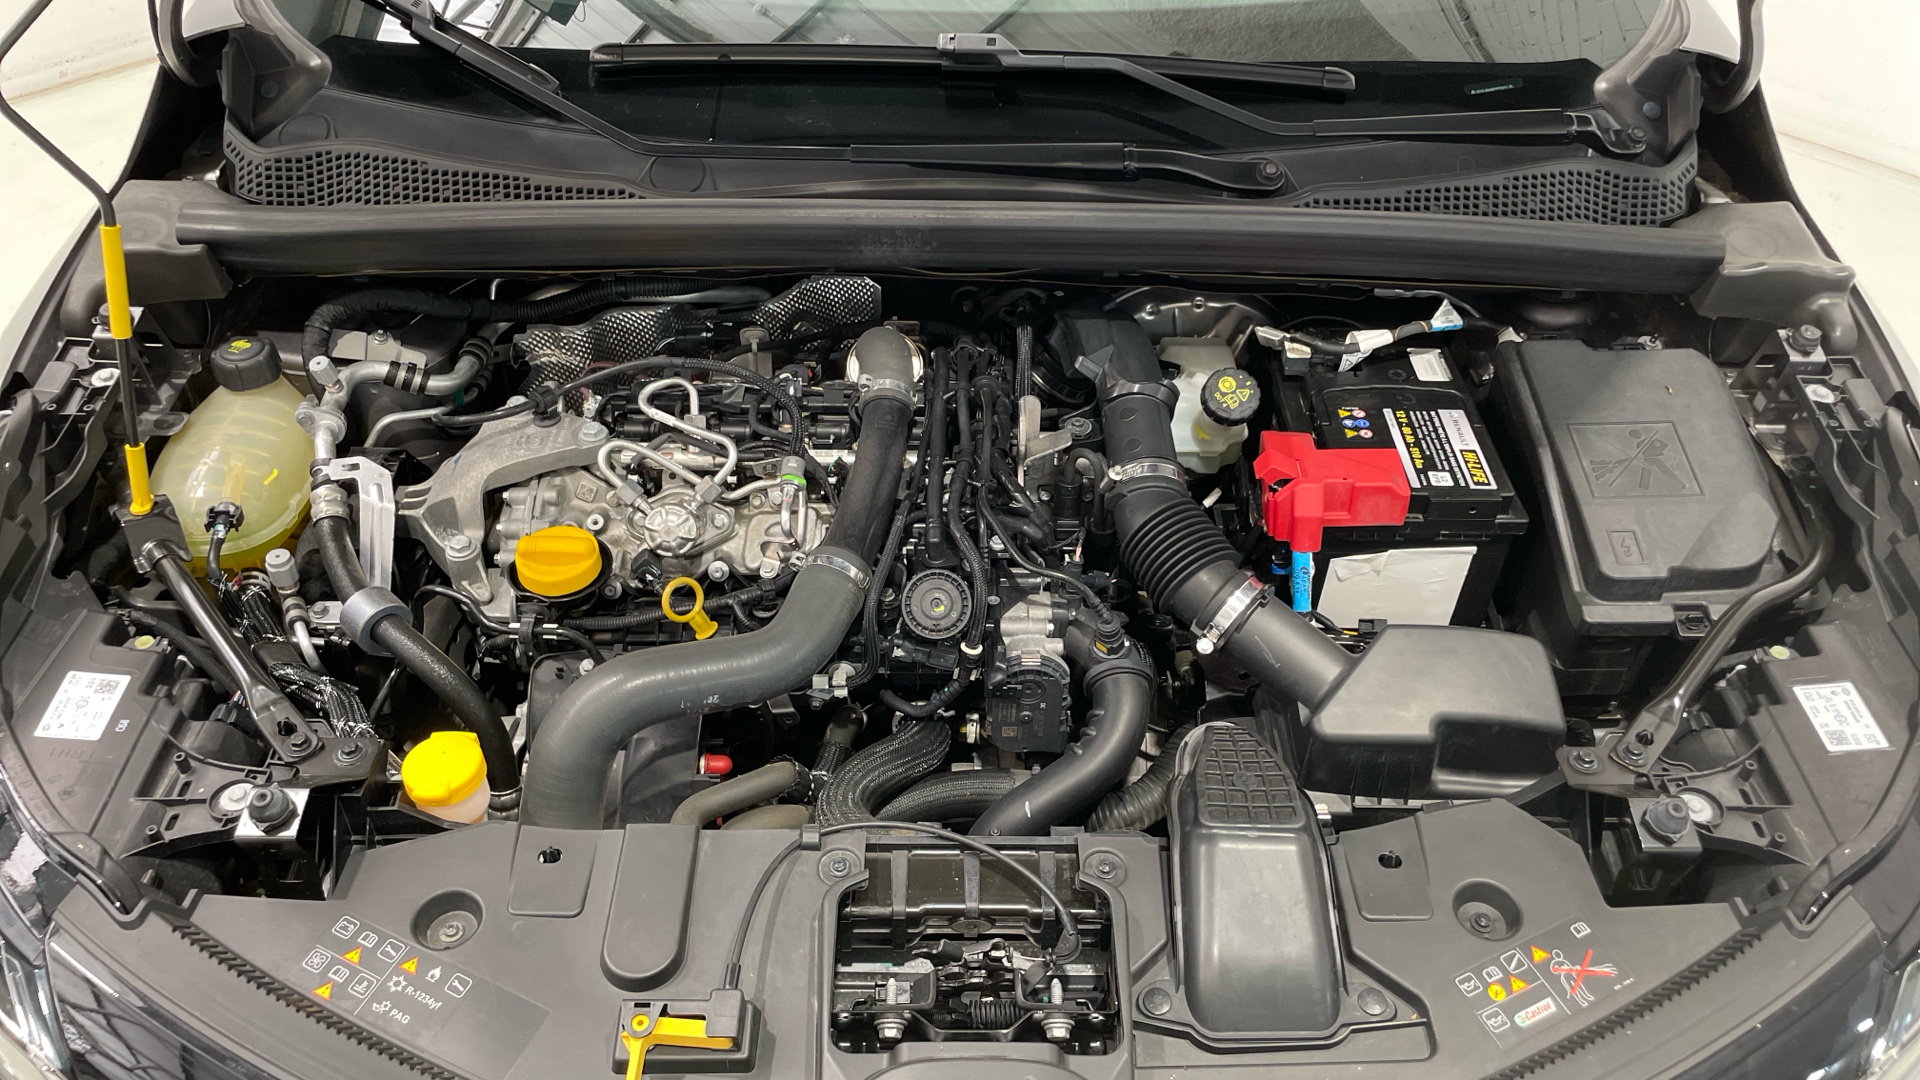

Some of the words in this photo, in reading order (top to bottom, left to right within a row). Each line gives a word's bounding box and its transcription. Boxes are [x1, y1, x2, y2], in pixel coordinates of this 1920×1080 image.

[1452, 419, 1469, 447] RENAULT
[404, 986, 443, 1010] R-1234yf
[389, 1009, 410, 1024] PAG
[1525, 1000, 1552, 1021] Castrol
